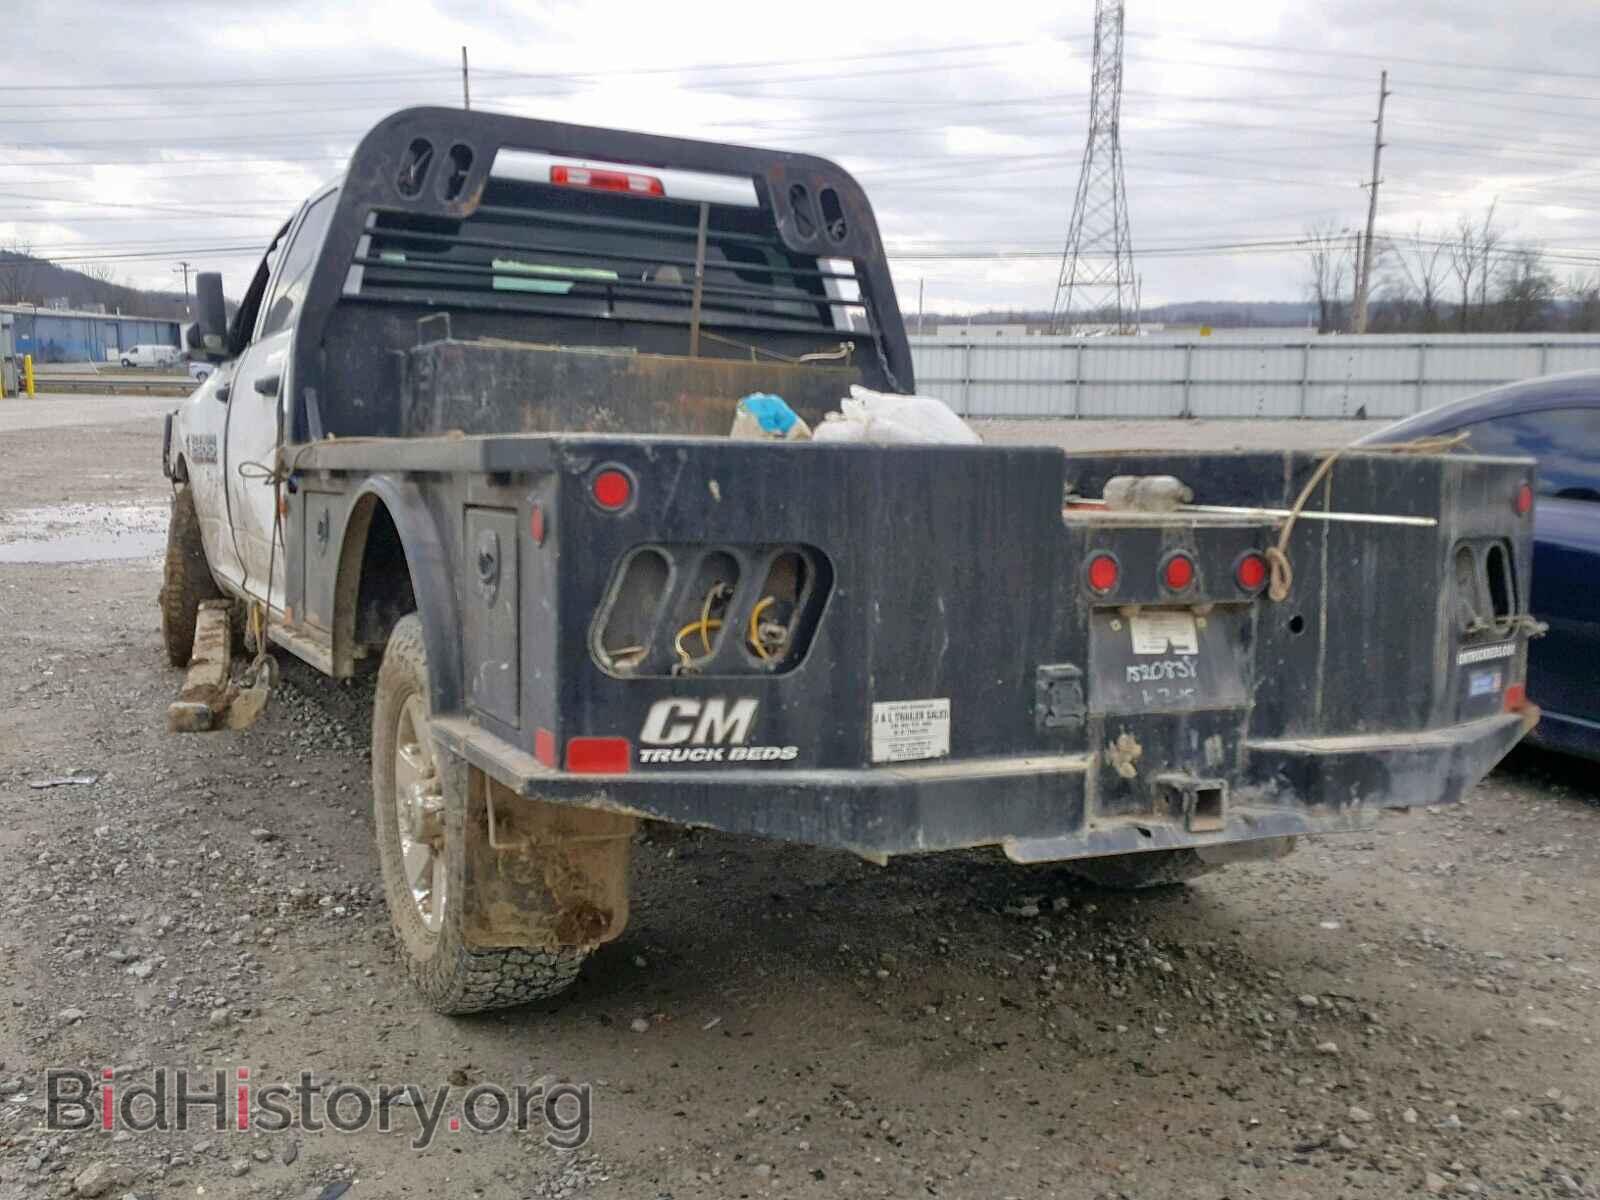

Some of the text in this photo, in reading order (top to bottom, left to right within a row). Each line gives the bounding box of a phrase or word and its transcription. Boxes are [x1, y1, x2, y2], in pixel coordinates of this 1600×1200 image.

[639, 698, 760, 745] CM
[639, 745, 799, 763] TRUCK BEDS
